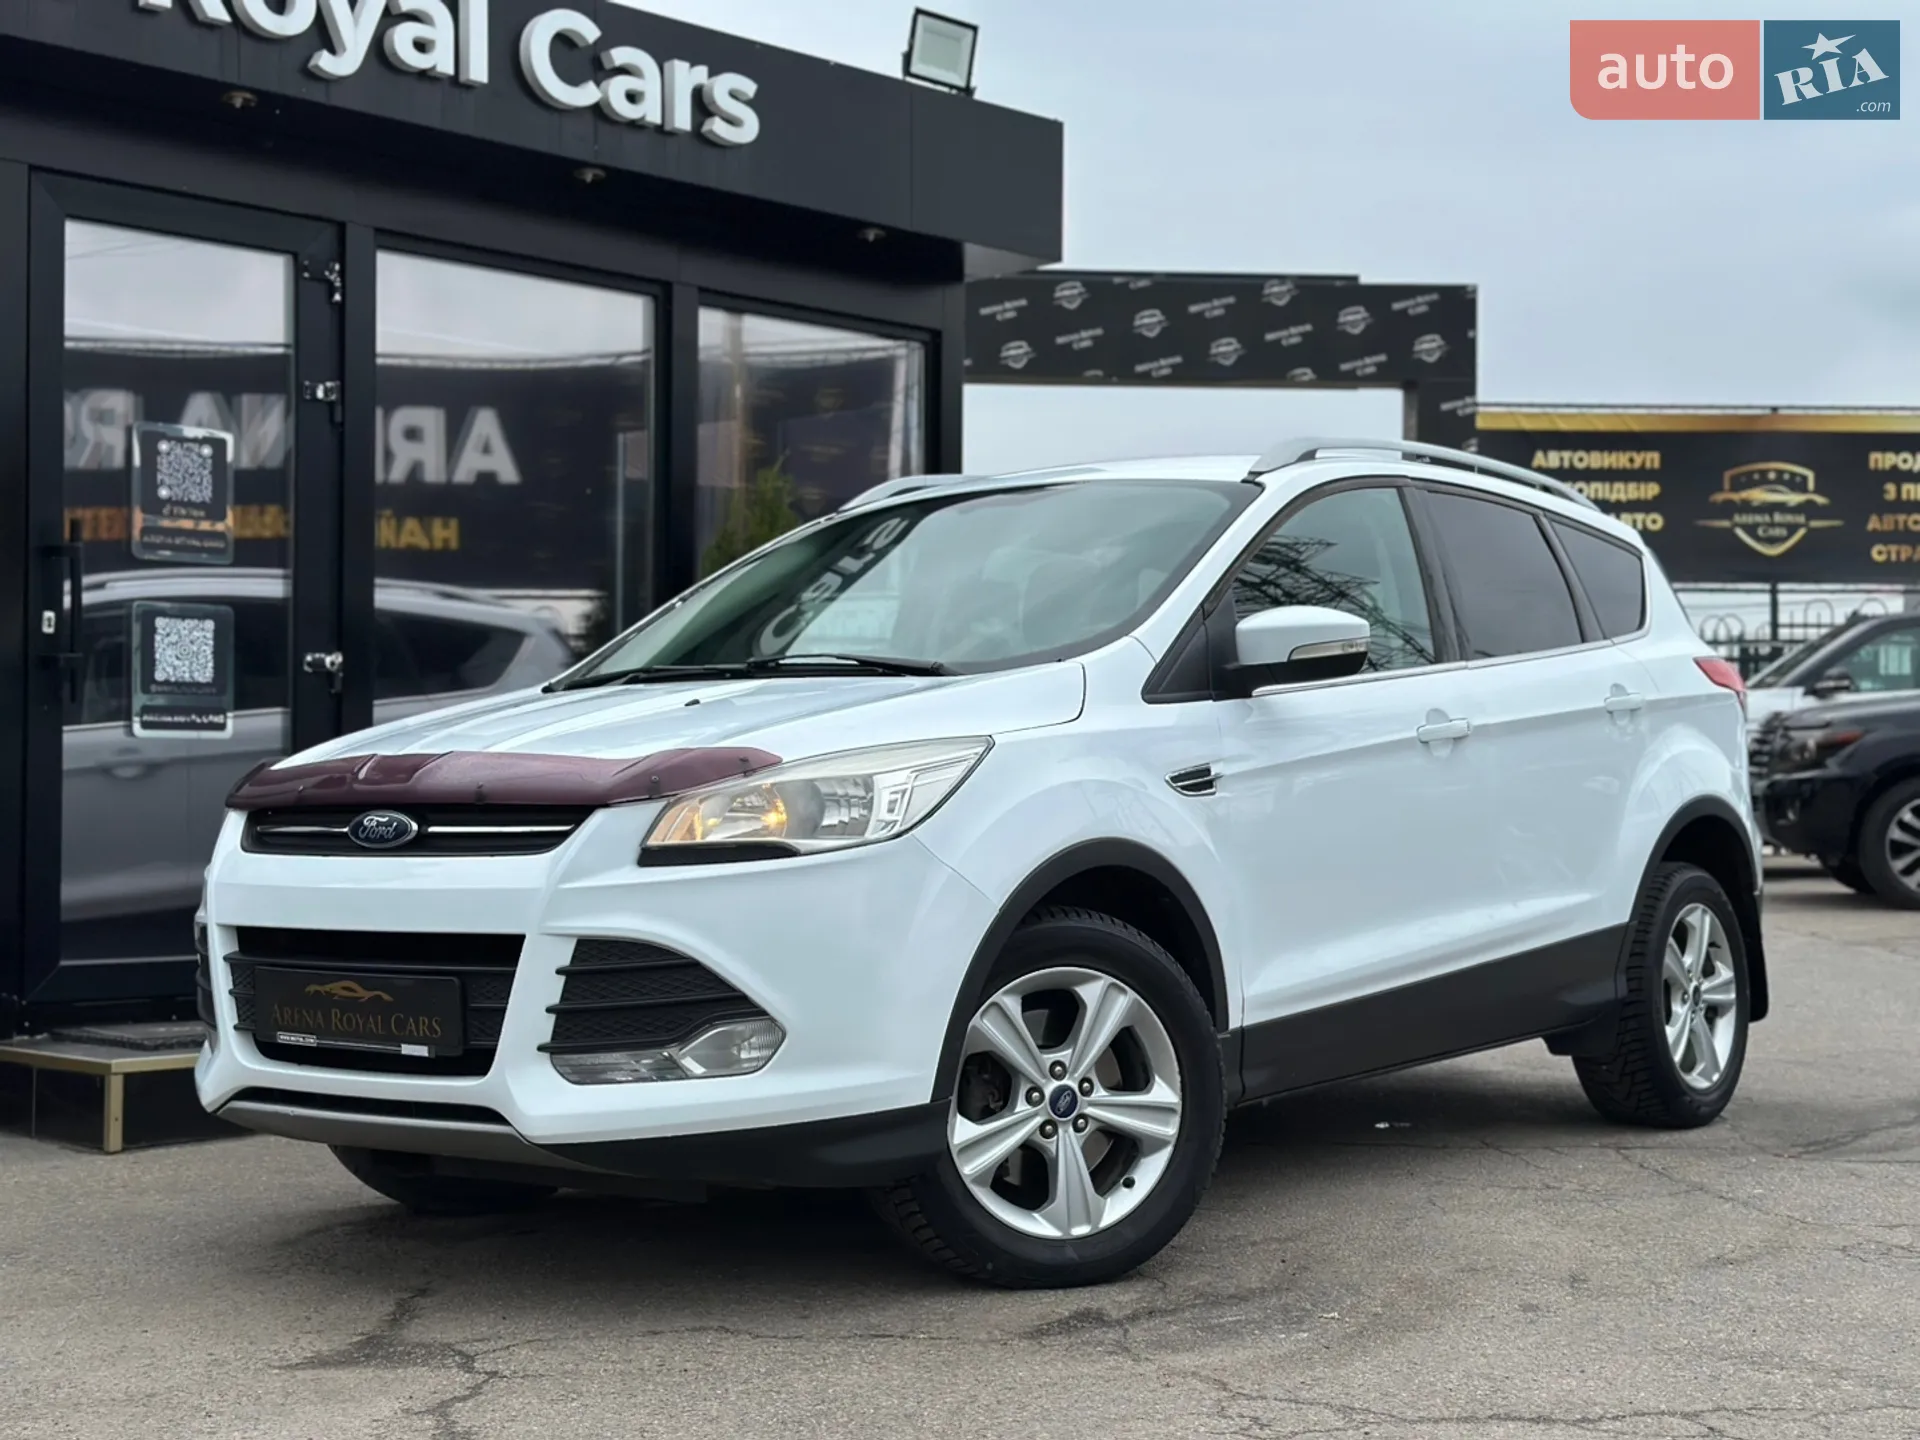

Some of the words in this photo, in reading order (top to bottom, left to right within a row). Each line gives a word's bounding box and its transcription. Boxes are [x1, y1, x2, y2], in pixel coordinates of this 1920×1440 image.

[138, 0, 490, 87] oyal
[519, 8, 760, 146] Cars
[1531, 449, 1661, 470] АВТОВИКУП
[1563, 481, 1661, 503] ОПІДБІР
[1901, 482, 1920, 501] П
[358, 815, 398, 839] Ford
[270, 1004, 326, 1029] ARENA
[331, 1008, 387, 1036] ROYAL
[391, 1013, 443, 1039] CARS
